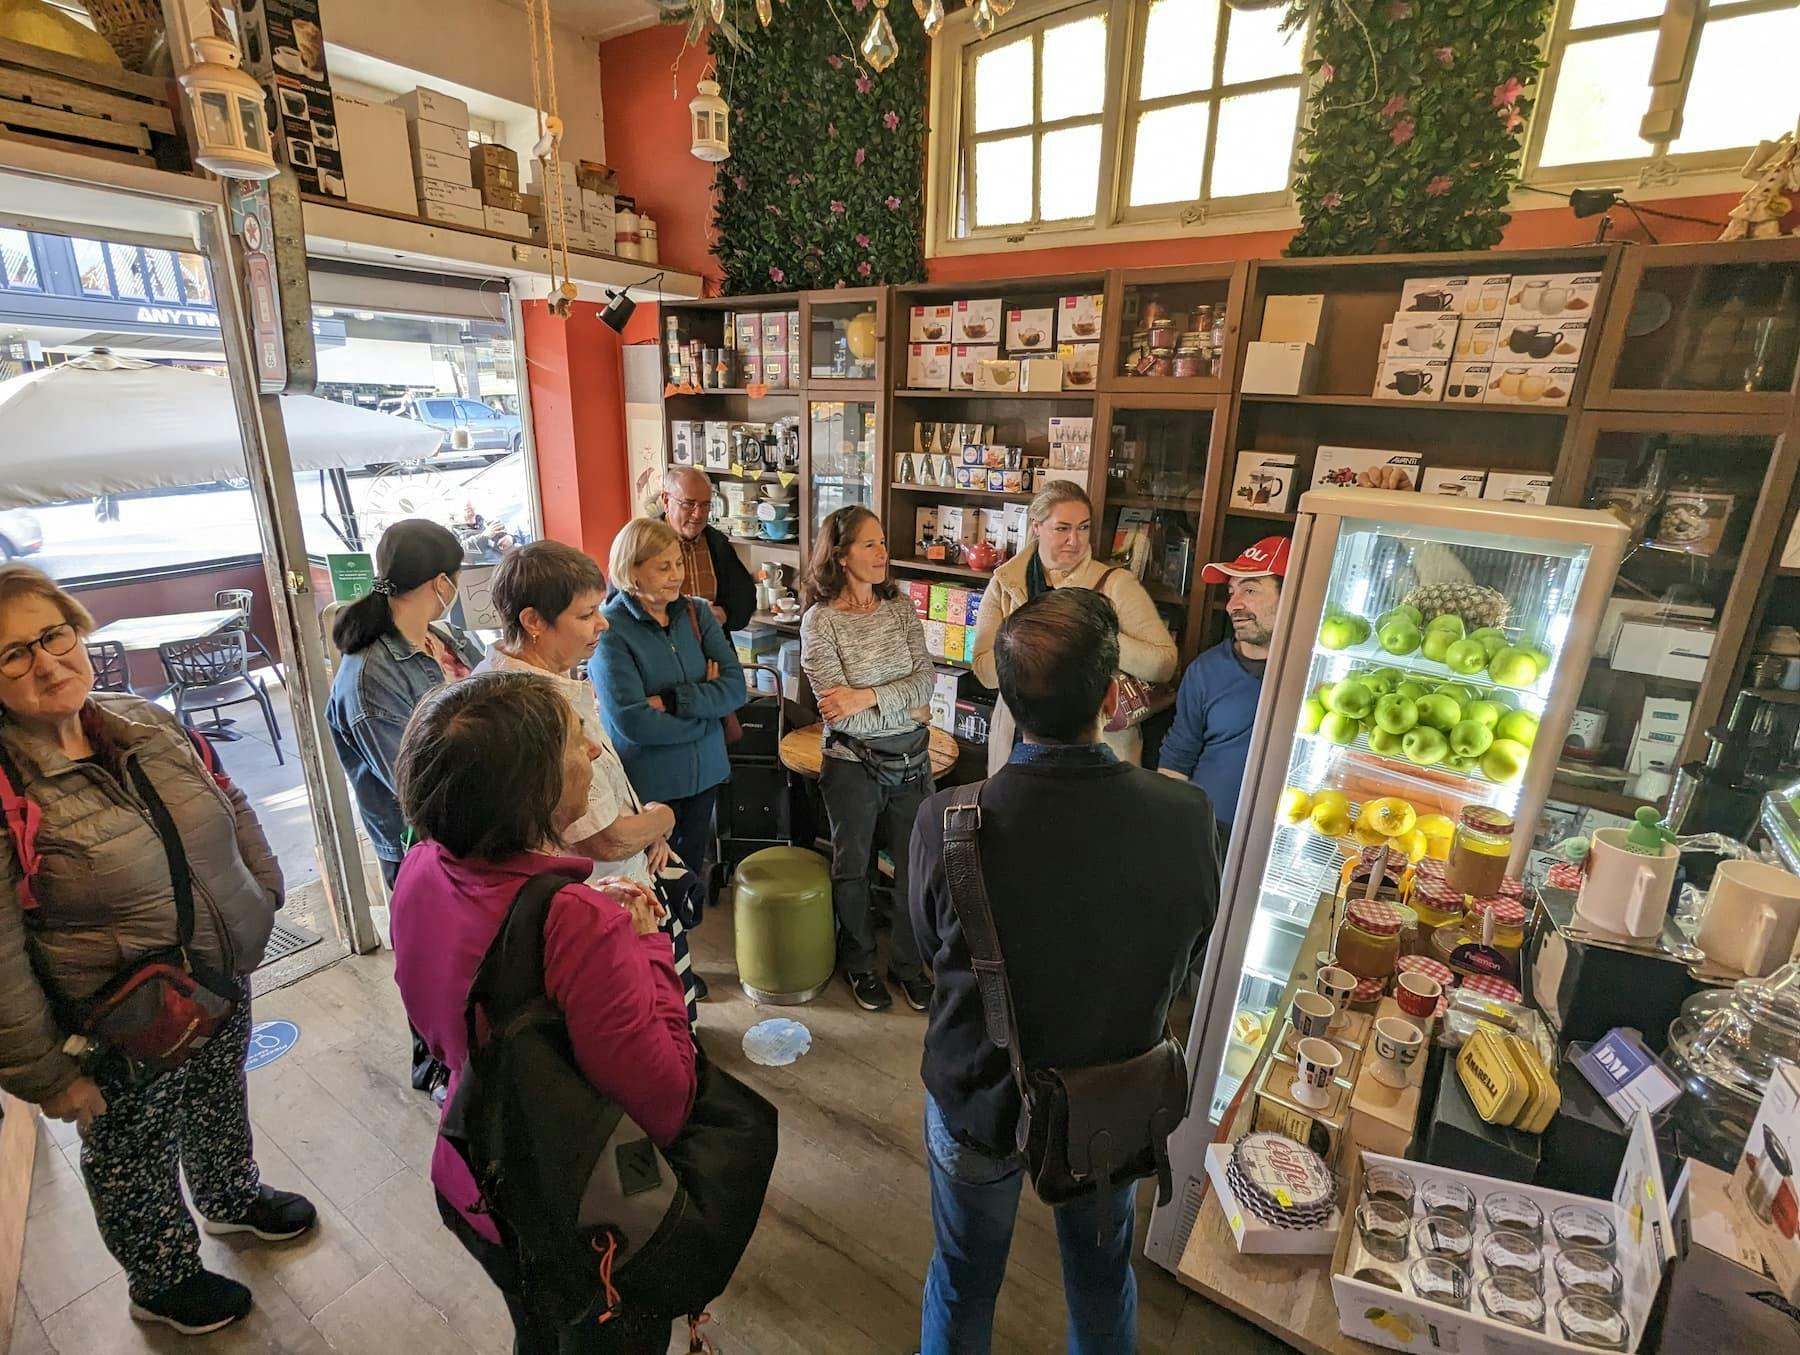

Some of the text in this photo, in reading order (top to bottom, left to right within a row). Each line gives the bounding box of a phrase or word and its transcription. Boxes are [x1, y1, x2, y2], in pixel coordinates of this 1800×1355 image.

[137, 306, 220, 327] ANYTIM
[1391, 456, 1418, 465] AVANTI
[1264, 1139, 1312, 1196] Coffee
